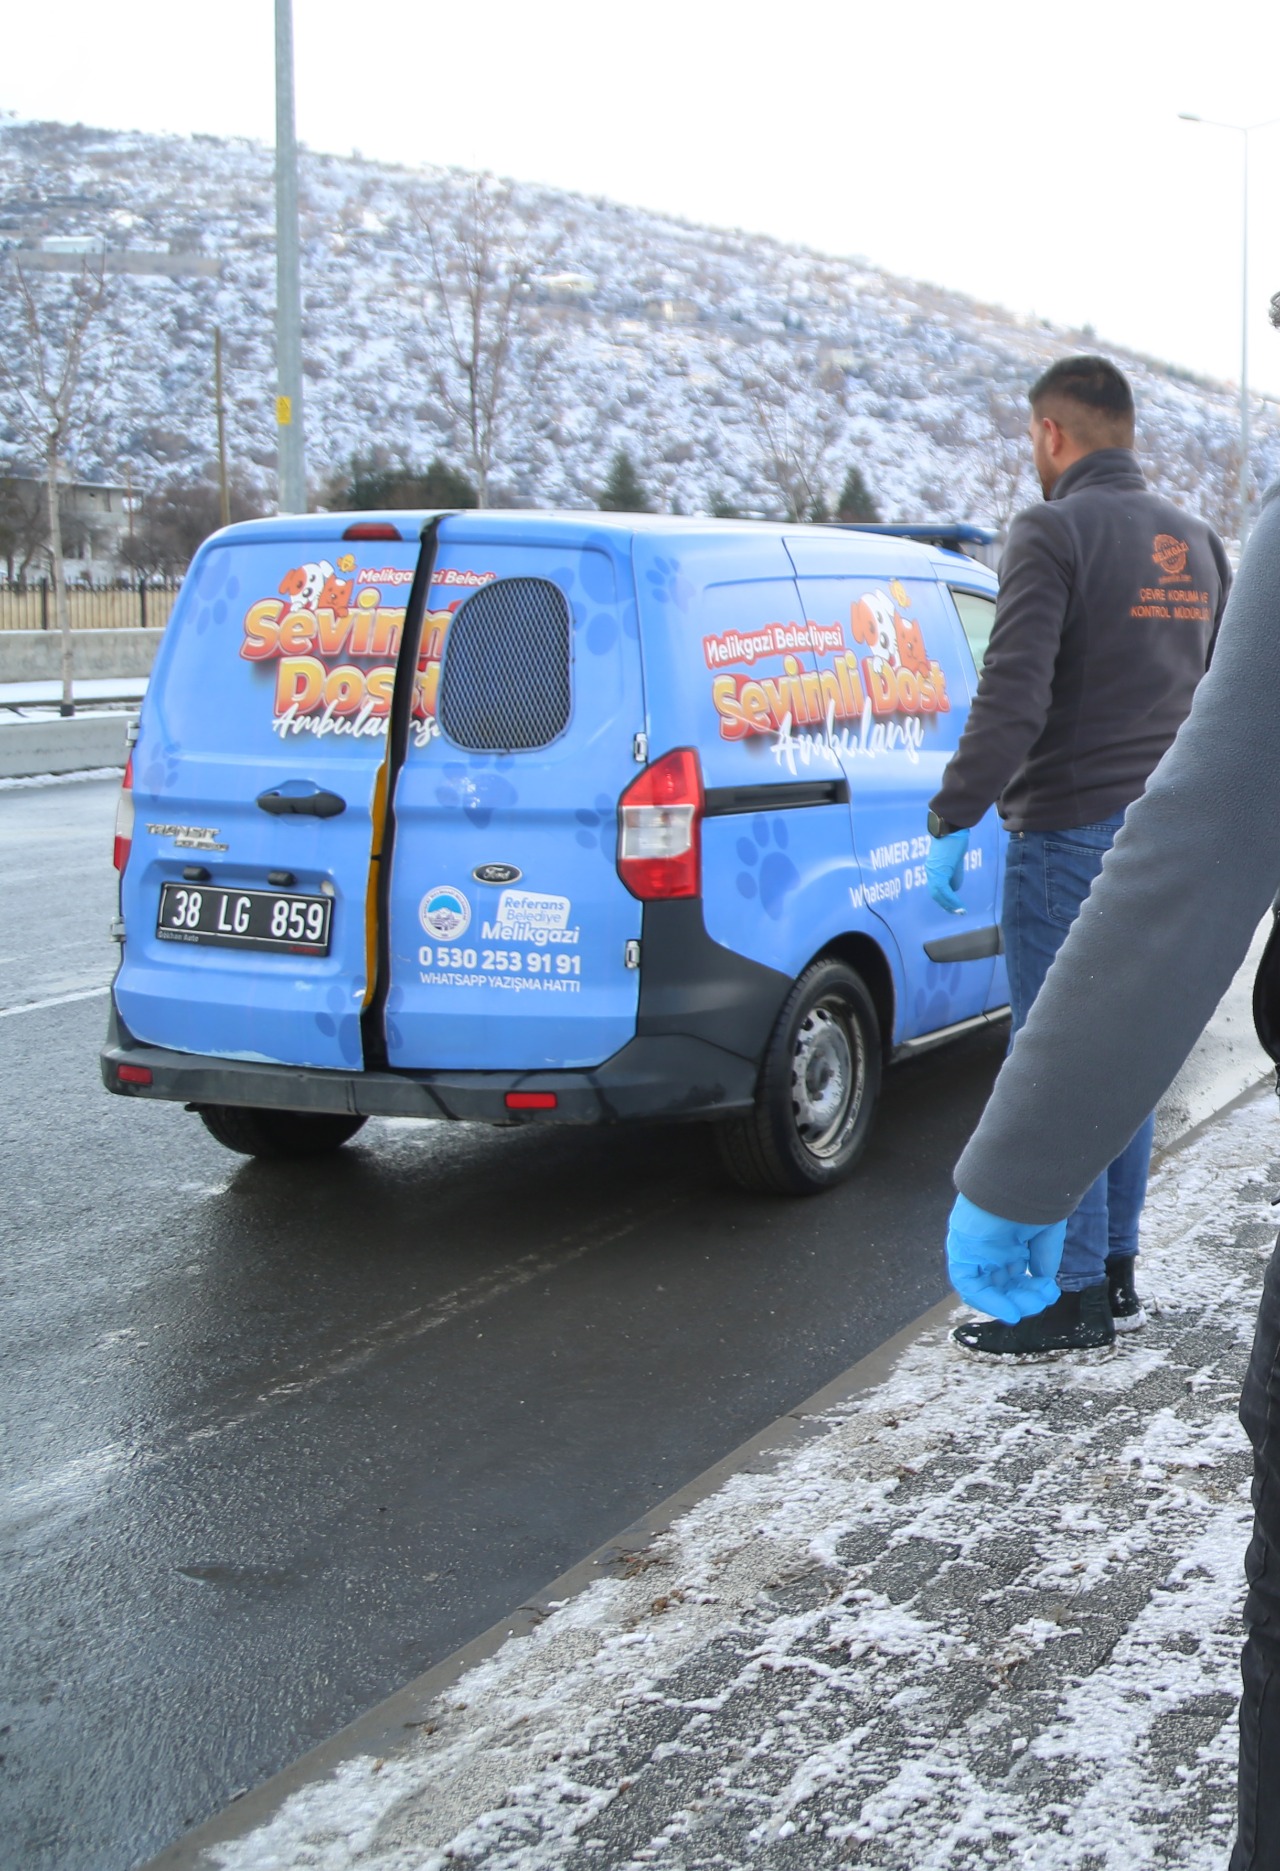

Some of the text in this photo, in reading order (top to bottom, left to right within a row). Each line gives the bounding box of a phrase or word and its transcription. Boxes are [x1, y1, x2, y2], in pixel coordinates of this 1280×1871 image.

[706, 626, 843, 664] Melikgazi Belediyesi
[712, 650, 952, 741] Sevimli Dost
[484, 866, 511, 880] Ford
[172, 890, 324, 940] 38 LG 859
[504, 896, 565, 911] Referans
[506, 909, 561, 925] Belediye
[481, 921, 580, 946] Melikgazi
[418, 946, 581, 975] 0 530 253 91 91
[419, 971, 581, 993] WHATSAPP YAZIŞMA HATTI
